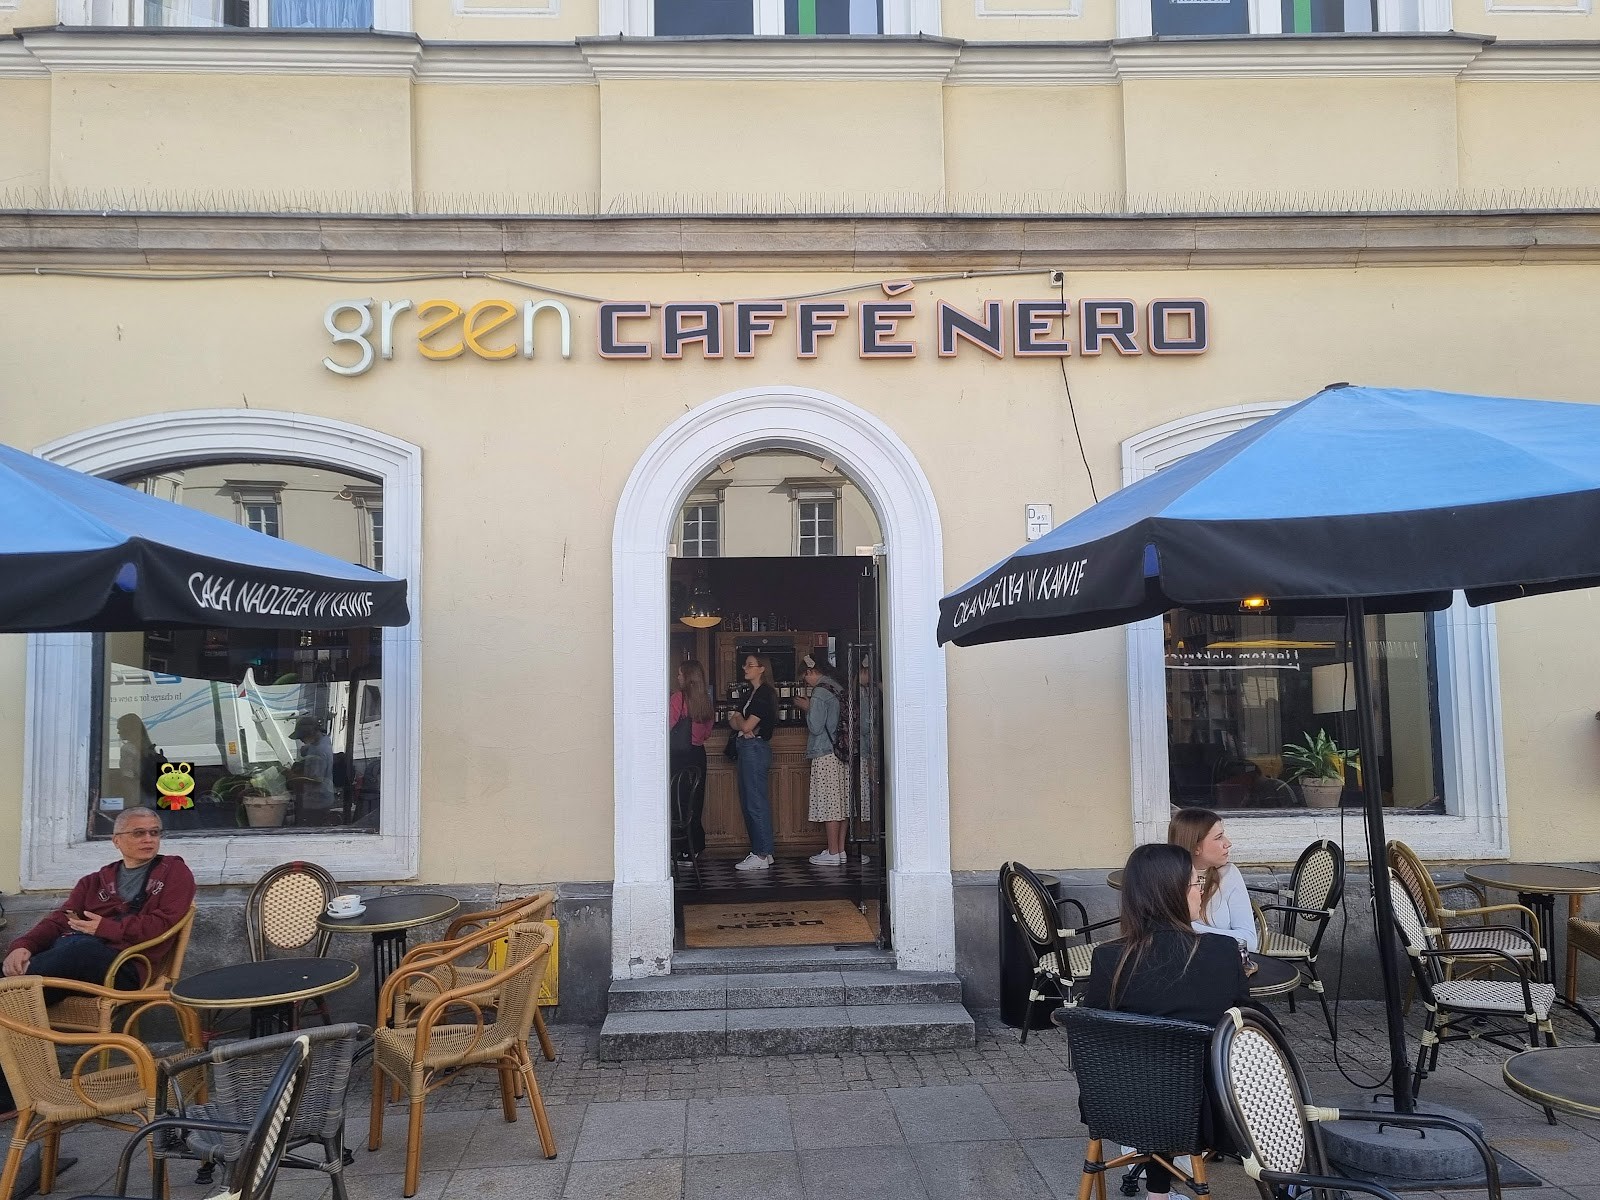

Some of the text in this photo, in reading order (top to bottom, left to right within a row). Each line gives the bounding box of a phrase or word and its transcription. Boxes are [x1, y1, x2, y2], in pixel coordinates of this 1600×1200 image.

[323, 298, 572, 377] green
[937, 297, 1209, 358] NERO
[188, 572, 235, 612] CAŁA
[235, 581, 317, 617] NADZIEJA
[314, 591, 336, 618] W
[1027, 568, 1039, 602] W
[1037, 558, 1088, 601] KAWIE
